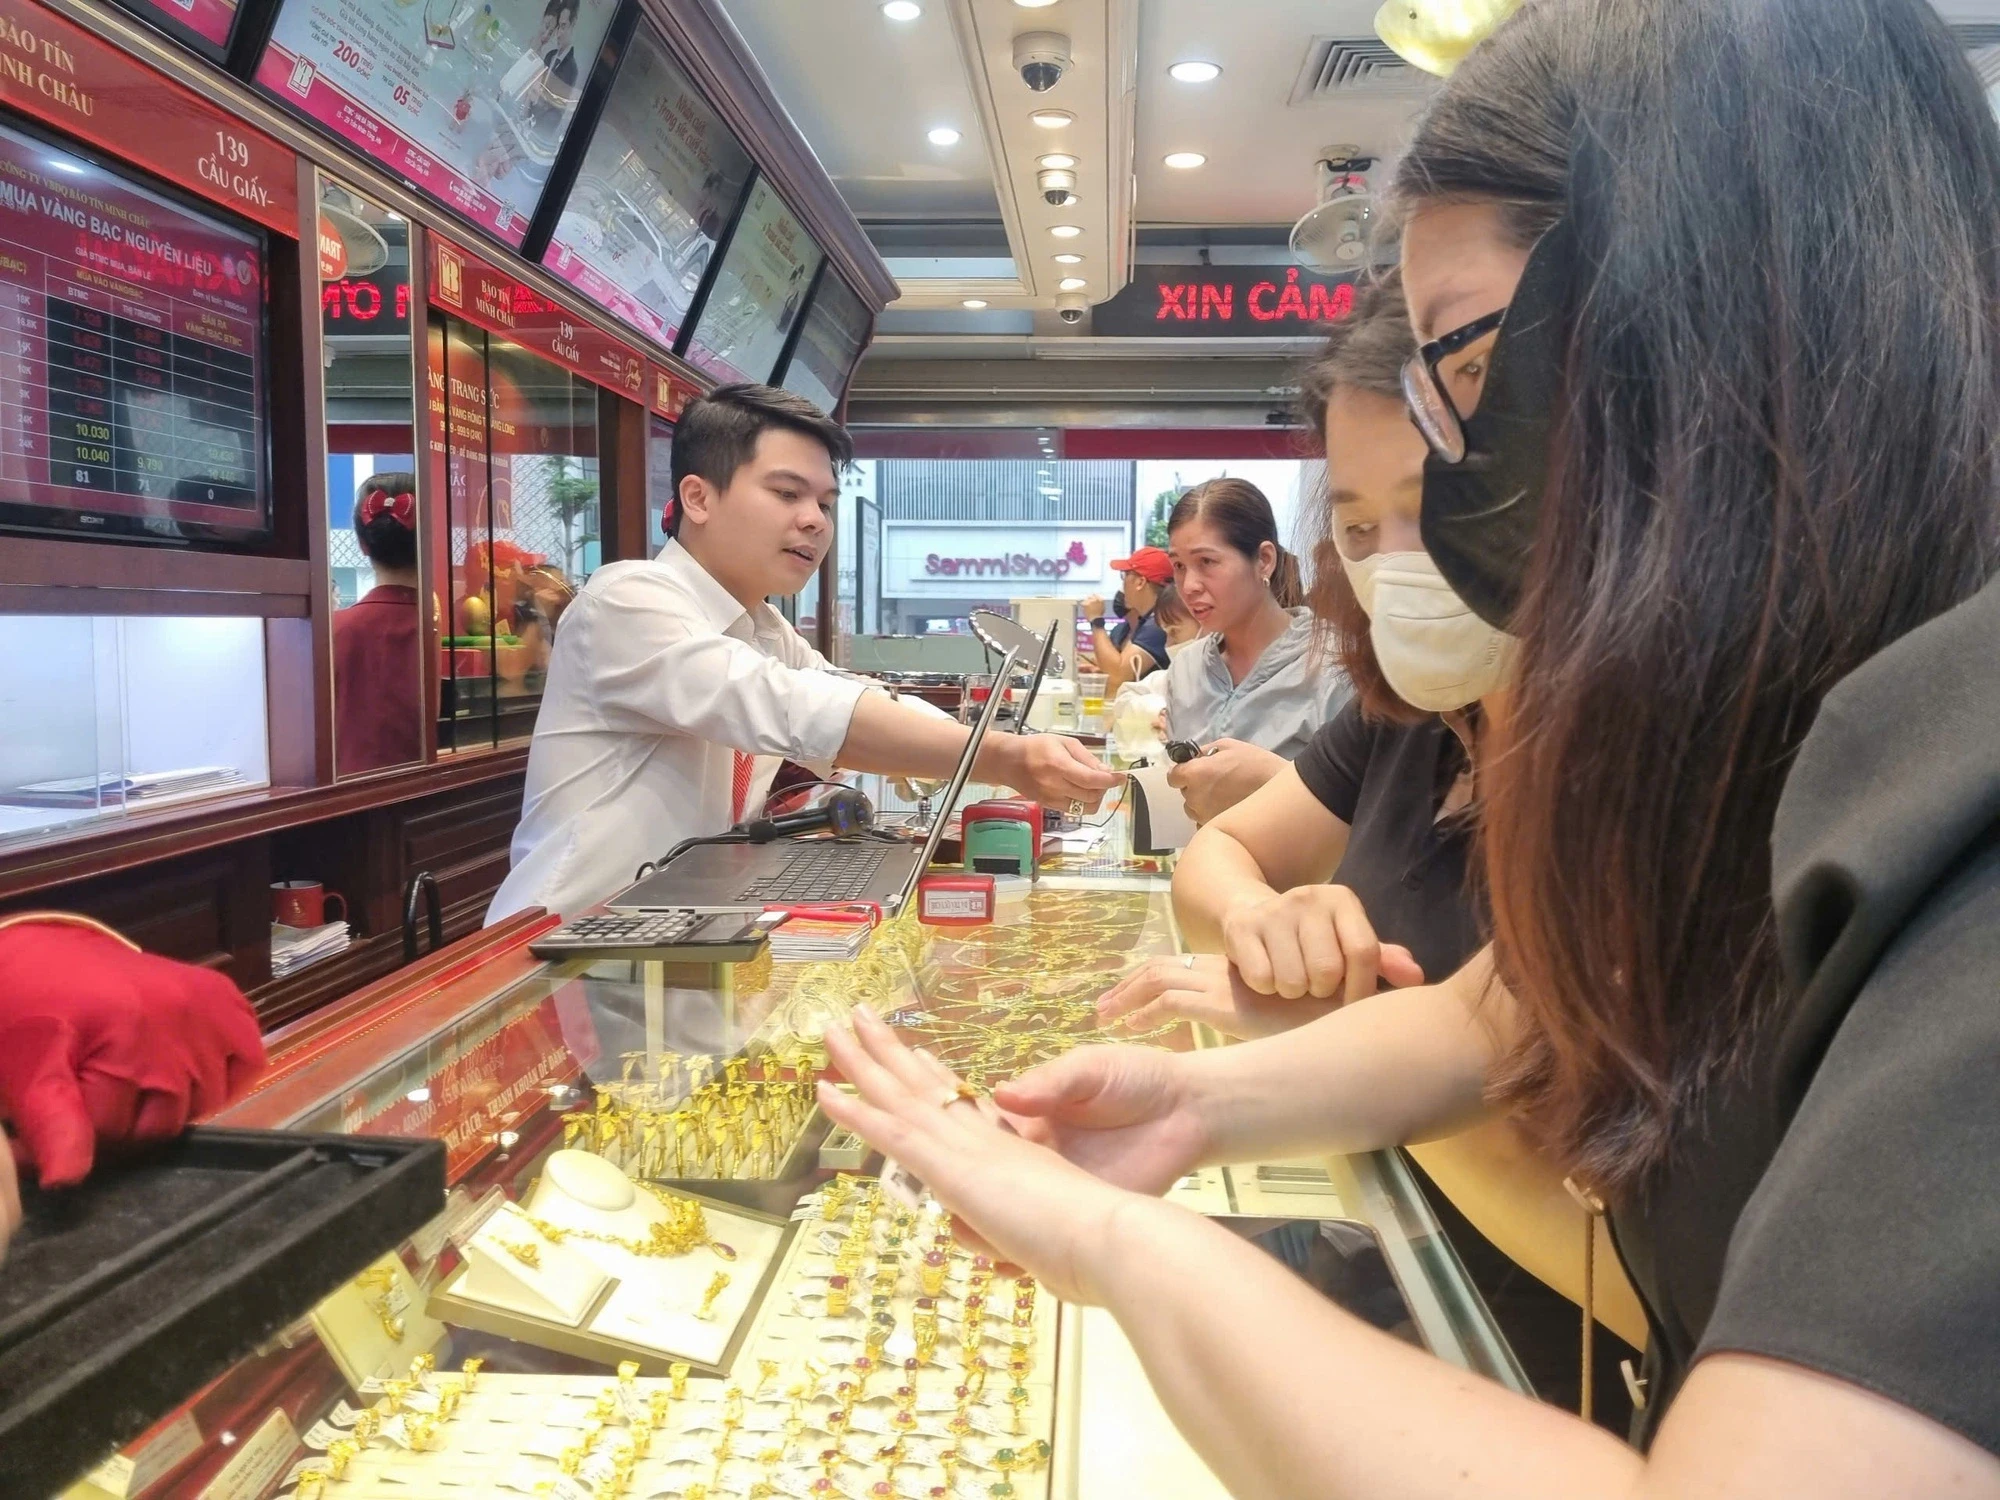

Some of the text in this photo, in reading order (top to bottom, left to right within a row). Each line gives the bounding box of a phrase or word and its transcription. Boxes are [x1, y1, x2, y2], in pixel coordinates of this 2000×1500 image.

[40, 39, 74, 75] TÍN
[333, 40, 360, 68] 200
[38, 73, 93, 116] CHÂU
[393, 85, 410, 105] 05
[216, 131, 249, 167] 139
[198, 153, 268, 207] CẦU GIẤY
[41, 196, 87, 228] VÀNG
[90, 215, 121, 241] BẠC
[125, 229, 181, 265] NGUYÊN
[185, 253, 212, 277] LIỆU
[482, 279, 497, 299] BẢO
[1156, 267, 1355, 321] XIN CẢM
[476, 296, 516, 329] MINH CHÂU
[559, 320, 574, 341] 139
[552, 336, 580, 363] CẦU GIẤY
[451, 378, 480, 403] TRANG
[76, 423, 110, 440] 10.030
[76, 446, 110, 463] 10.040
[75, 470, 90, 484] 81
